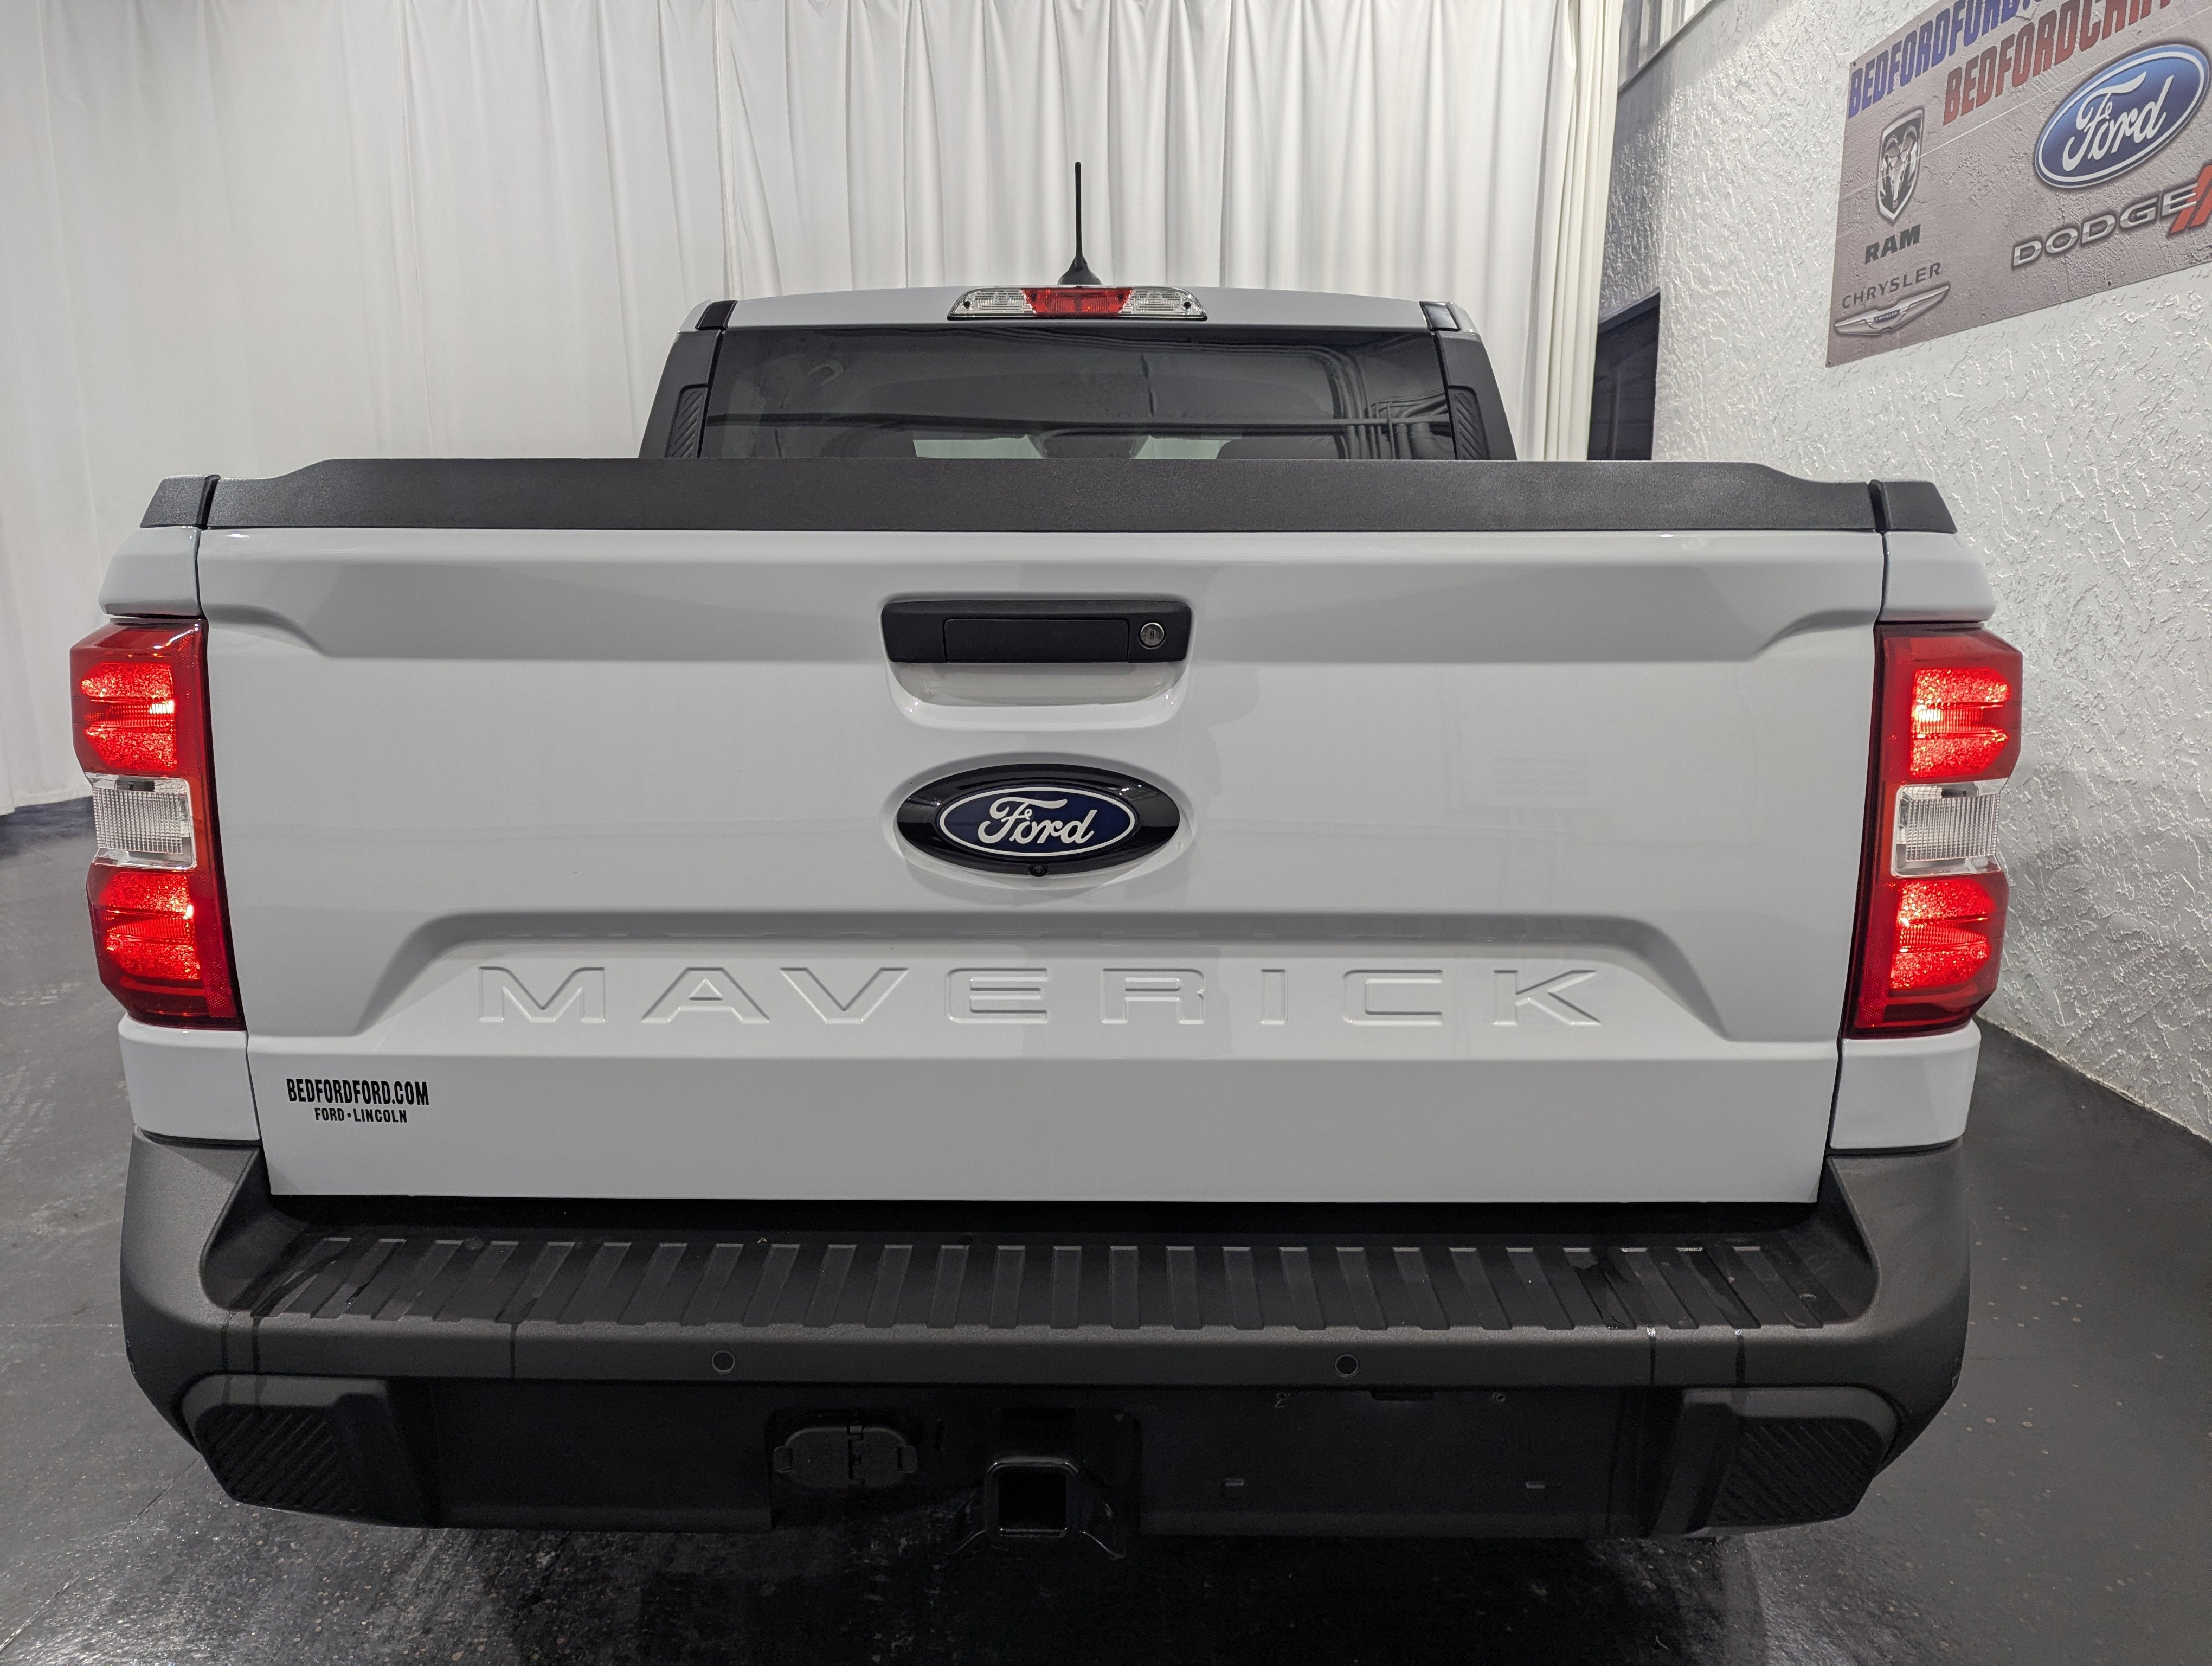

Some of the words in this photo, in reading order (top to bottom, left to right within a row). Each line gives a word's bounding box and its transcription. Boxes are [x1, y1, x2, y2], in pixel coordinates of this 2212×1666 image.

[2062, 71, 2174, 172] Ford
[1864, 223, 1921, 265] RAM
[2013, 183, 2197, 266] DODGE
[1842, 262, 1941, 309] CHRYSLER
[978, 797, 1097, 844] Ford
[478, 966, 1602, 1026] MAVERICK
[286, 1078, 429, 1106] BEDFORDFORD.COM
